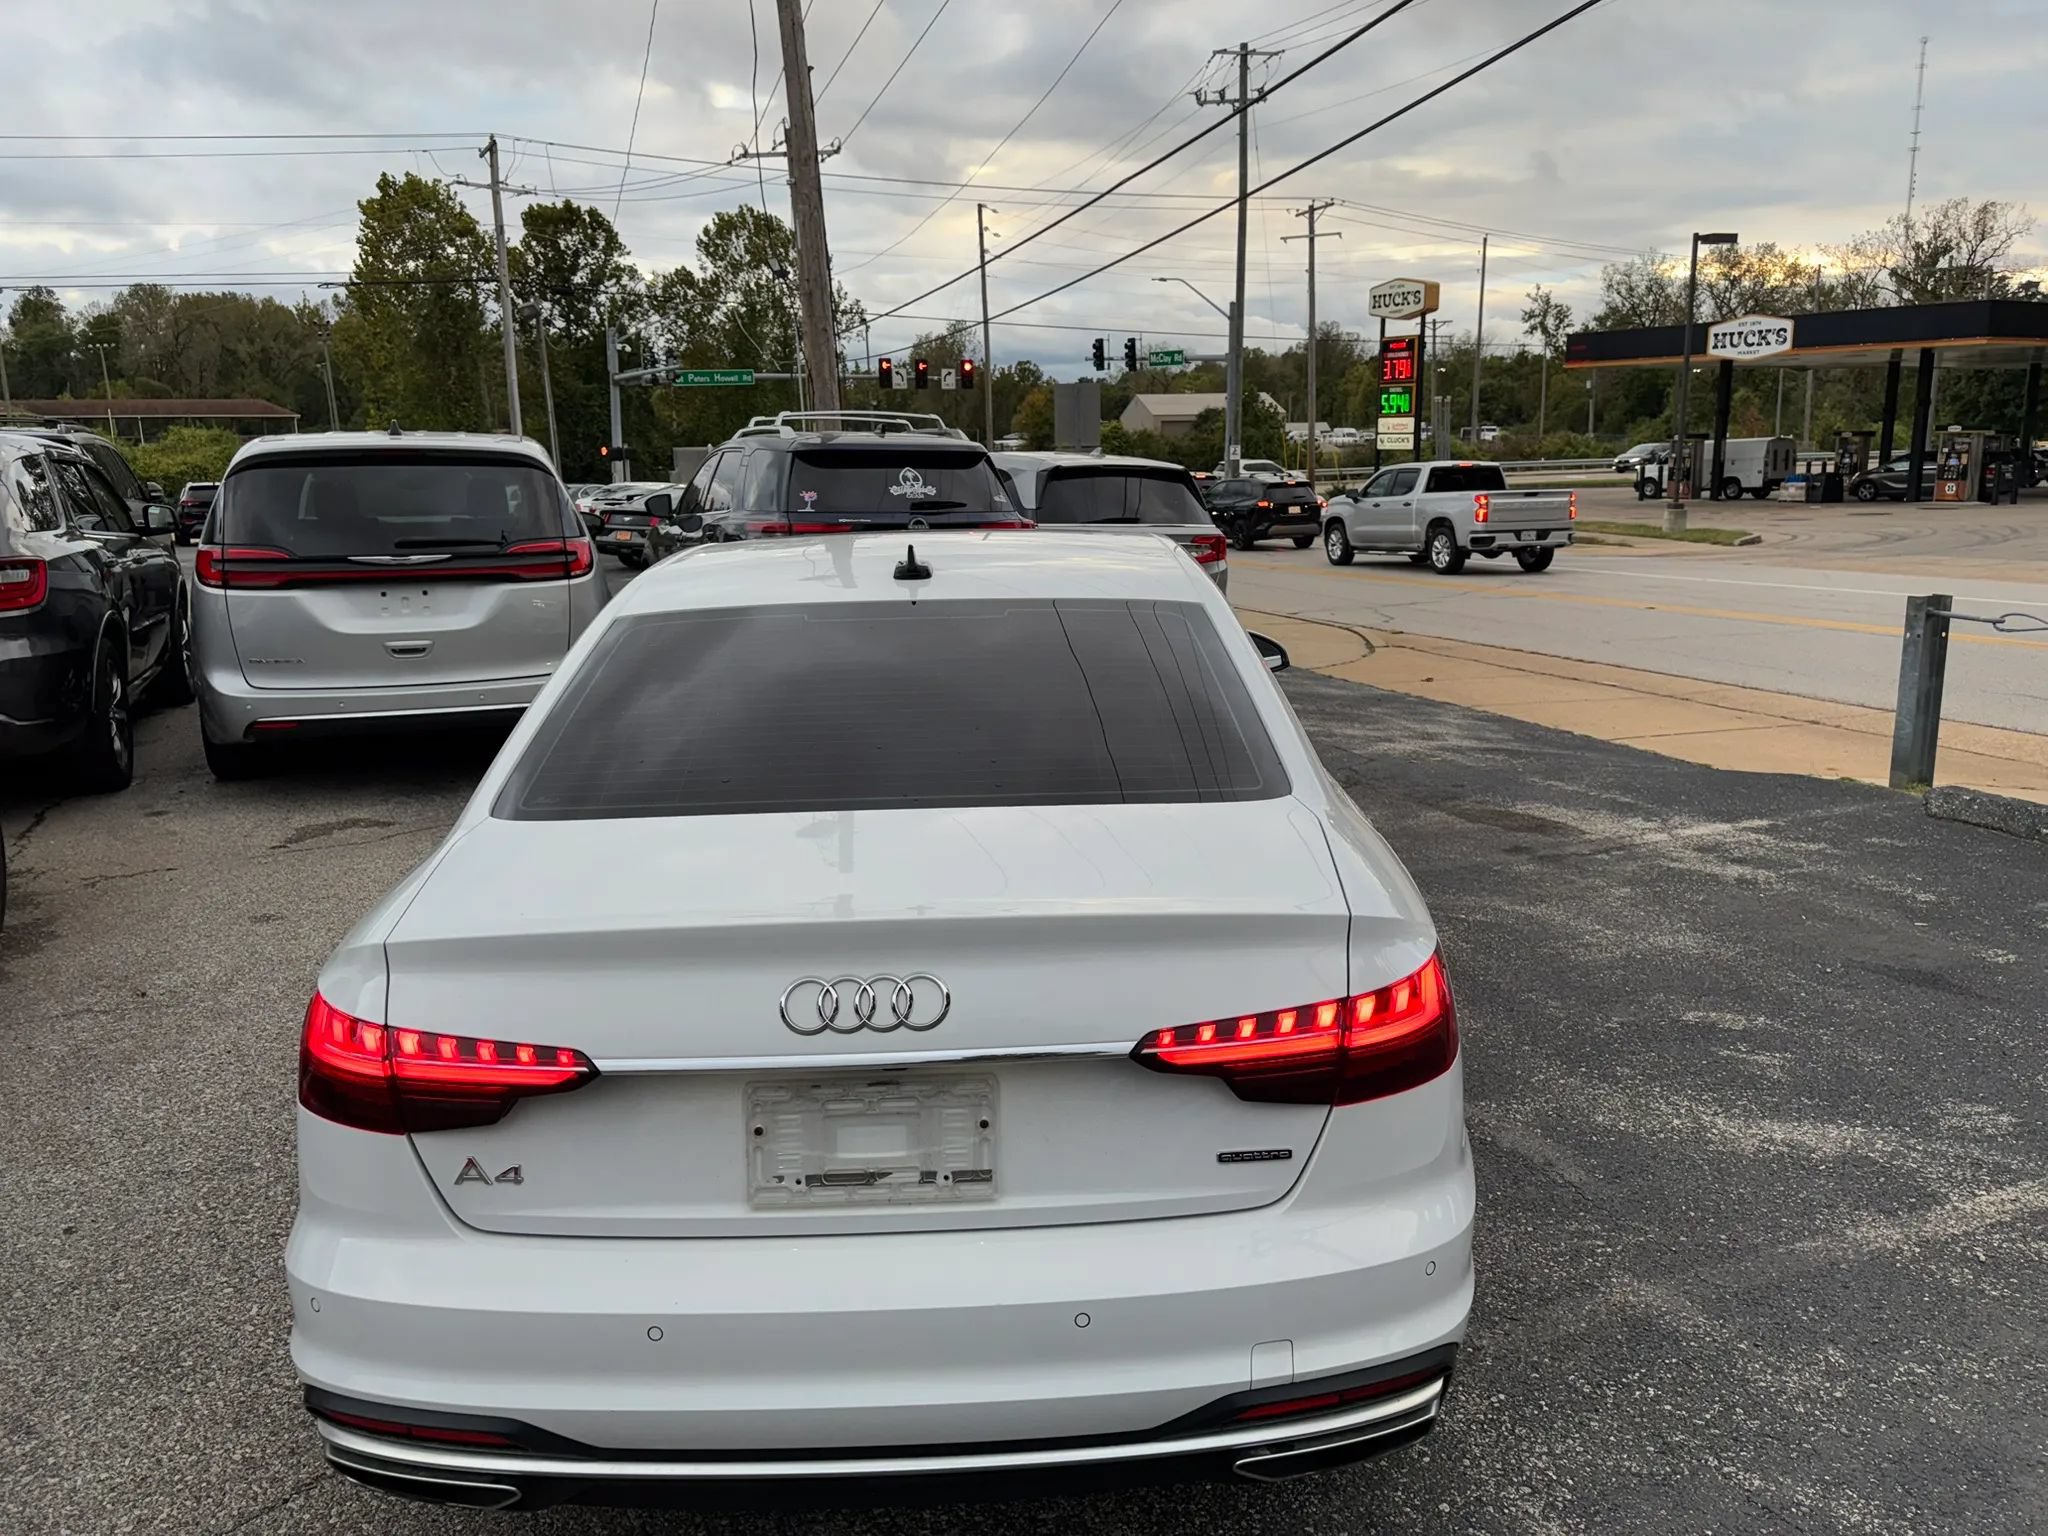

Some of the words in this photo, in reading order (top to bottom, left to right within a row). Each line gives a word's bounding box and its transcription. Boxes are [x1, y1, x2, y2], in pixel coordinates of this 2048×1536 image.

[1372, 290, 1421, 309] HUCK'S
[1712, 328, 1788, 349] HUCK'S
[688, 374, 710, 383] Peters
[1219, 1150, 1290, 1162] quattro
